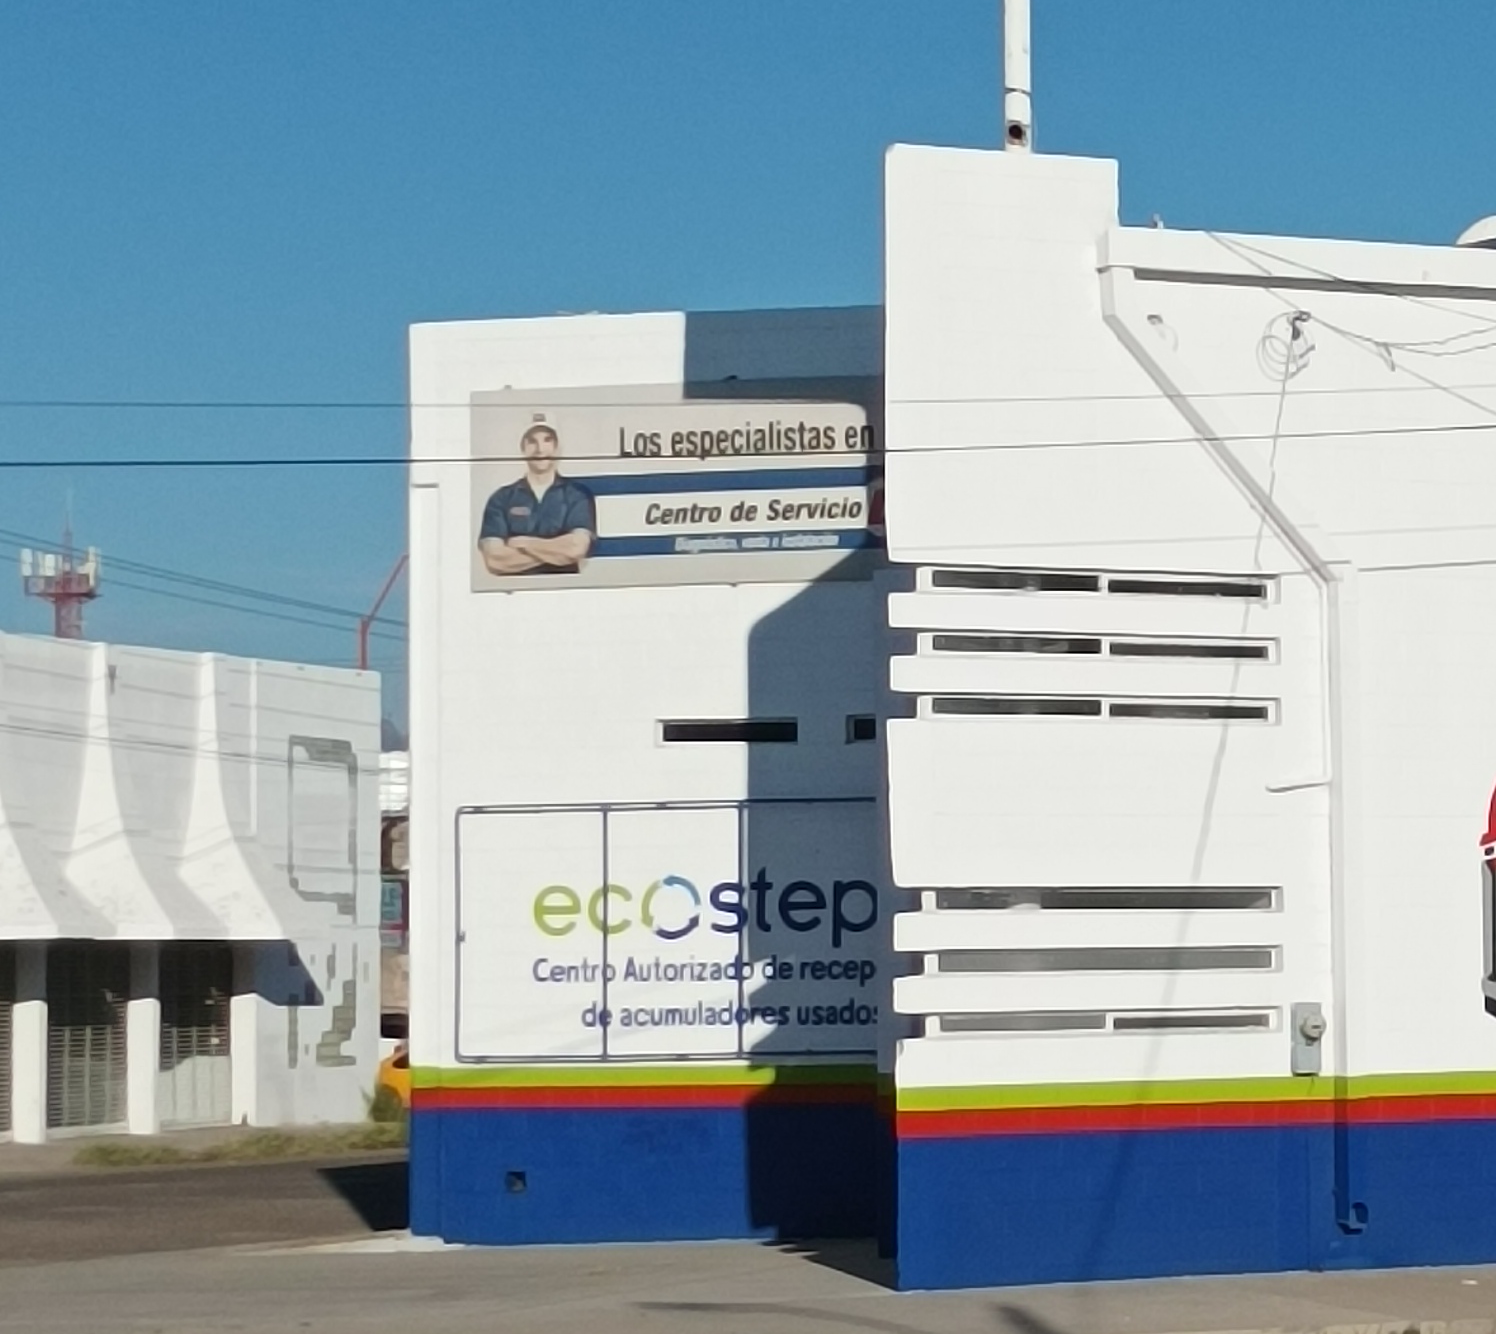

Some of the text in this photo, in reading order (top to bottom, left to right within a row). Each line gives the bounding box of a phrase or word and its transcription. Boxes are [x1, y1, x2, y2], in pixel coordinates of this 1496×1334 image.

[620, 420, 874, 460] Los especialistas en
[645, 502, 722, 526] Centro
[730, 499, 758, 522] de
[766, 496, 862, 523] Servicio
[532, 867, 878, 948] ecostep
[532, 954, 876, 987] Centro Autorizado de recep
[581, 1001, 613, 1028] de
[620, 998, 790, 1027] acumuladores
